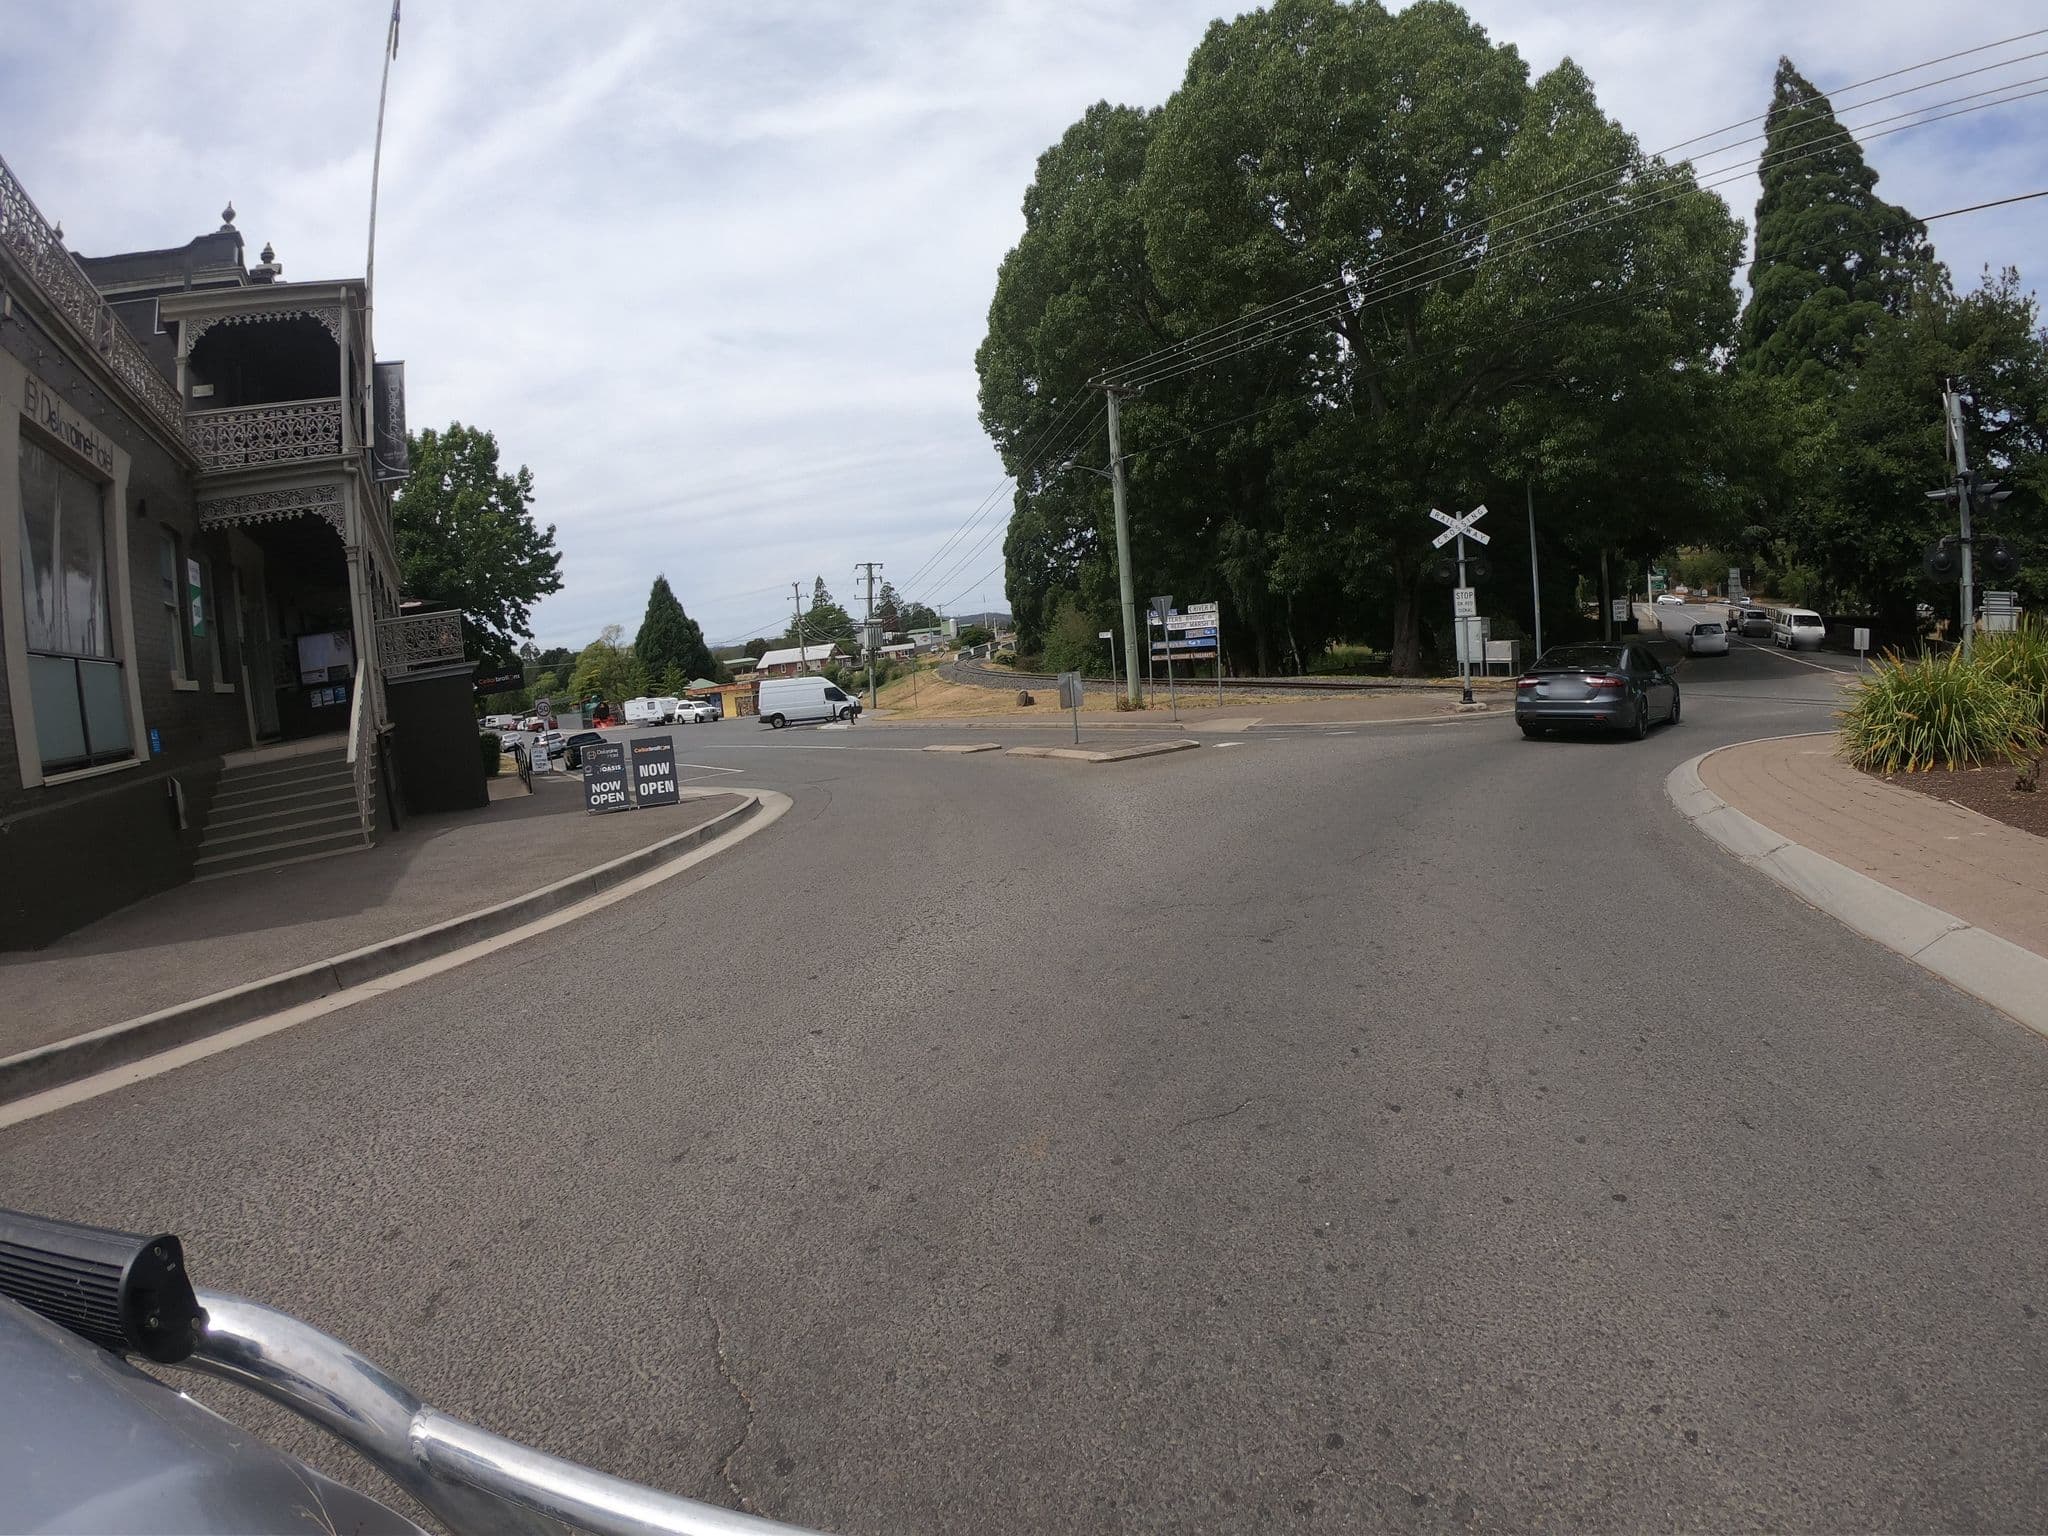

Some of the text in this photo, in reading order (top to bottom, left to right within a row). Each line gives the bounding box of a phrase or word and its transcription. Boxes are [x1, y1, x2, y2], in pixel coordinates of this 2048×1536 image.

[1437, 508, 1484, 545] CROSSING
[1455, 591, 1474, 600] STOP
[538, 705, 548, 713] 50
[601, 764, 622, 773] OASIS
[639, 761, 670, 778] NOW
[591, 780, 621, 794] NOW
[639, 780, 675, 796] OPEN
[590, 791, 625, 805] OPEN
